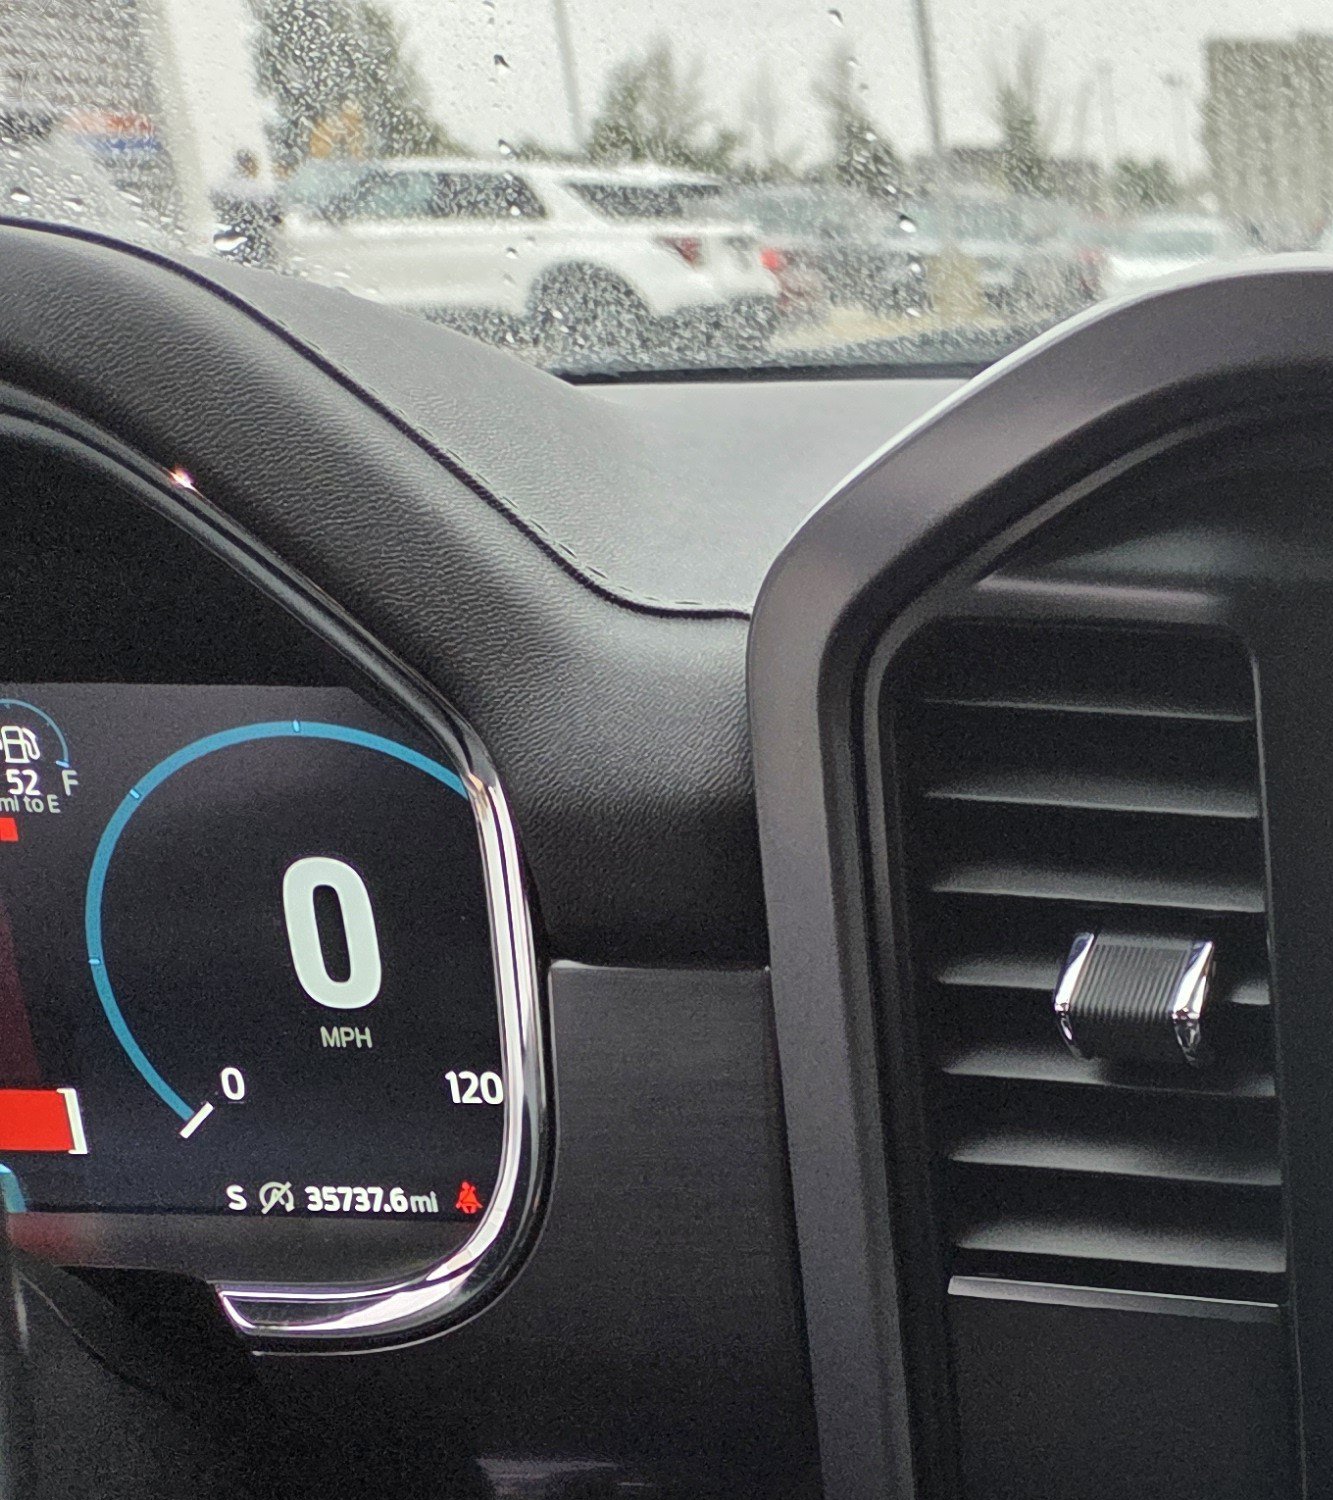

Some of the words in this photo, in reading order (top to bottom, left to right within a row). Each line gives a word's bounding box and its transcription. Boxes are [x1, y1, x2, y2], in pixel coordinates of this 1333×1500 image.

[6, 769, 41, 795] 52
[62, 770, 78, 796] F
[23, 796, 44, 813] to
[47, 795, 61, 813] E
[282, 856, 382, 1009] 0
[320, 1026, 372, 1048] MPH
[221, 1067, 245, 1101] 0
[445, 1071, 503, 1103] 120
[227, 1186, 246, 1211] S
[307, 1186, 408, 1213] 35737.6
